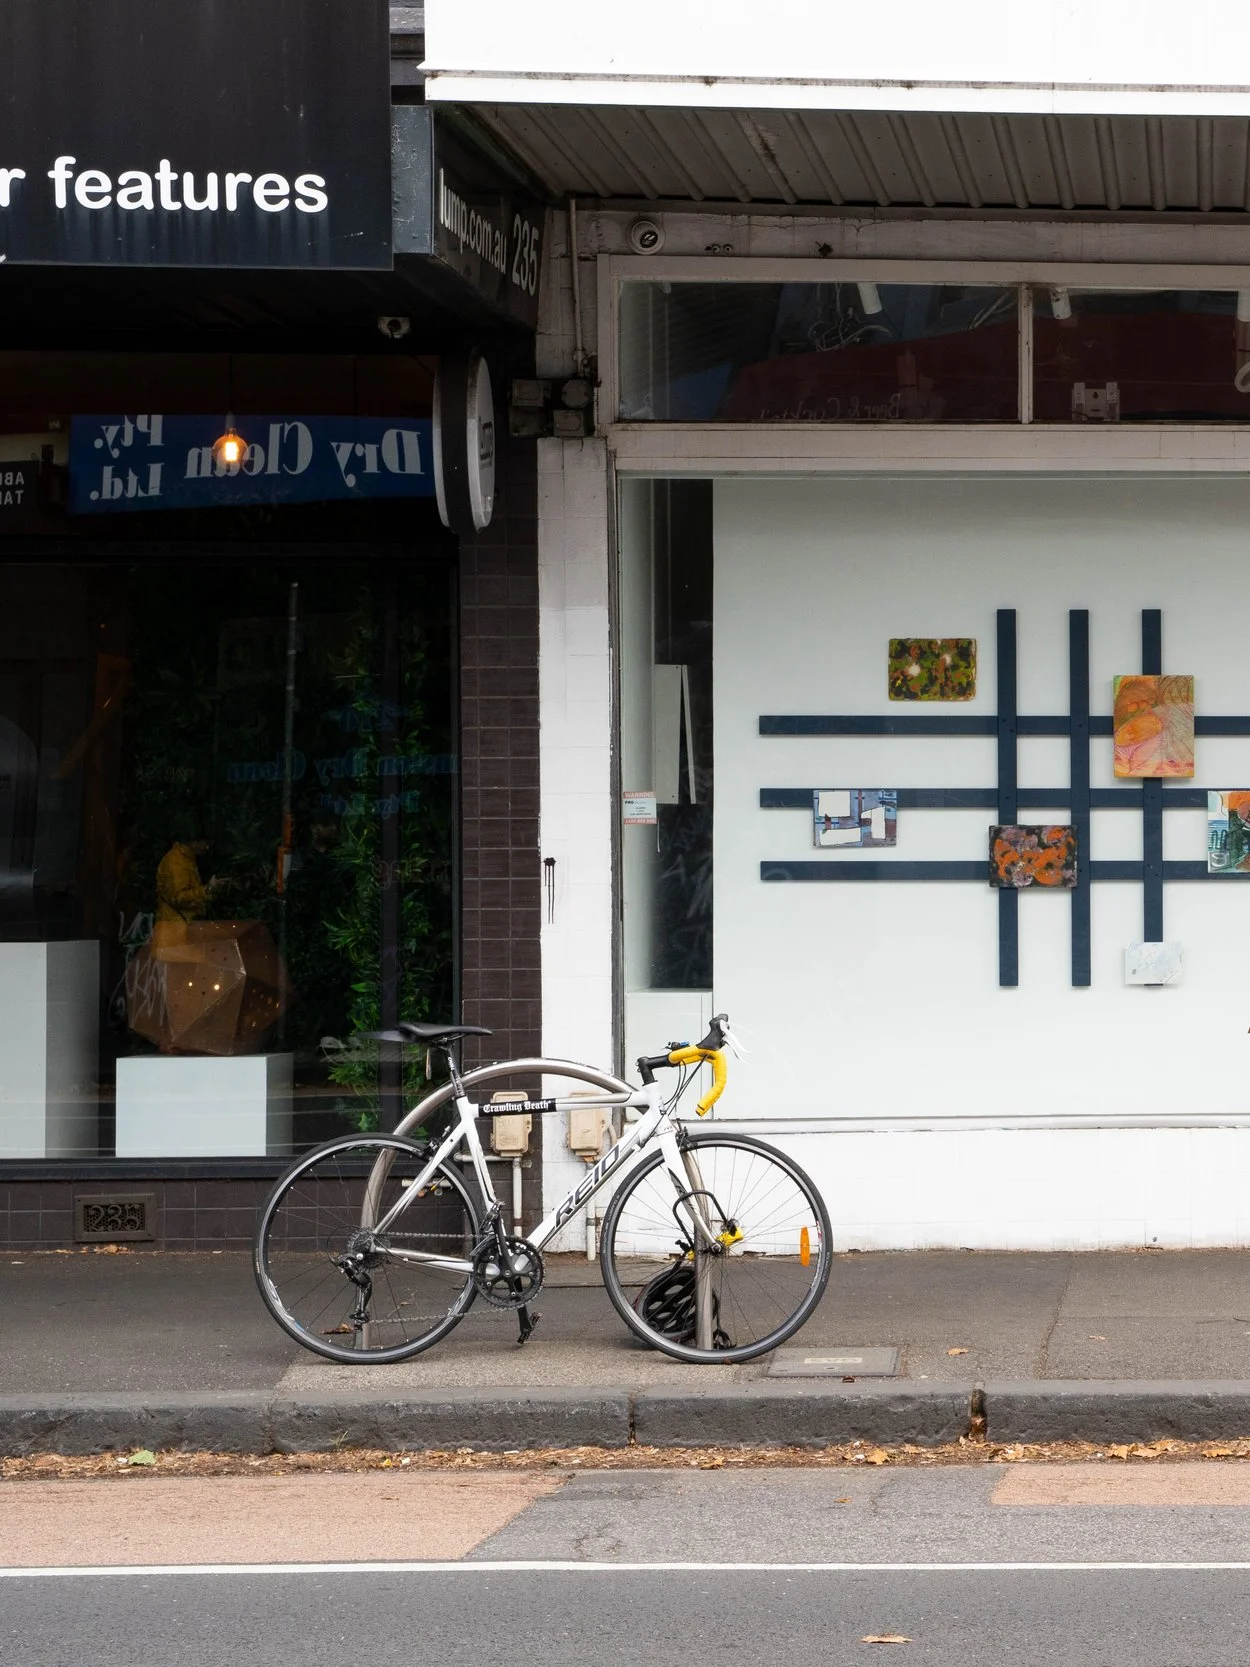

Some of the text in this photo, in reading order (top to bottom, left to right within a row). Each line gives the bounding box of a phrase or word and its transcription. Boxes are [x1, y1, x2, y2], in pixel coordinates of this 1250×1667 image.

[48, 156, 329, 213] features
[439, 167, 539, 297] lump.com.au 235
[483, 1103, 522, 1113] Crawling
[555, 1144, 619, 1229] REID
